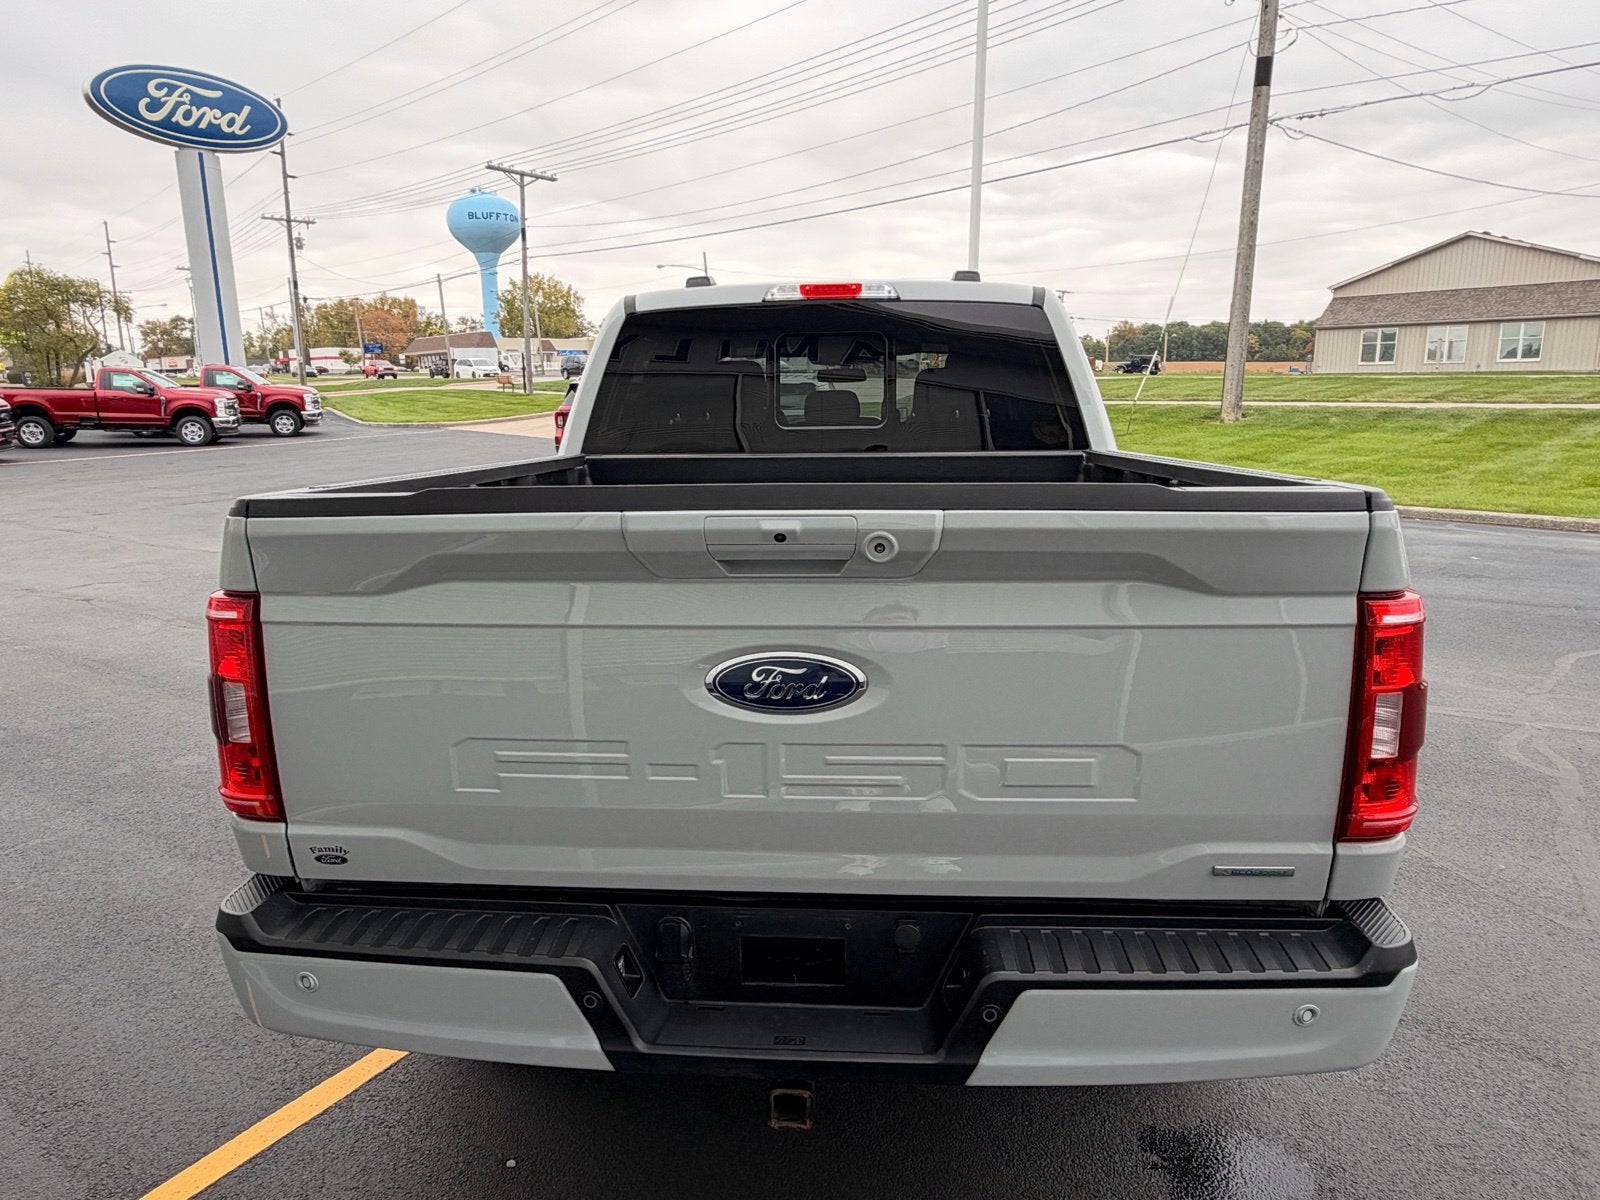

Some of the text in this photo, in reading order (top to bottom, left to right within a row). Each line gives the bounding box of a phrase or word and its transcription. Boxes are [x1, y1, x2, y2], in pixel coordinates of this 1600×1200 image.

[138, 78, 251, 135] Ford
[467, 211, 519, 223] BLUFFTON
[743, 660, 829, 700] Ford
[451, 737, 1142, 802] F-150
[309, 845, 350, 856] Family
